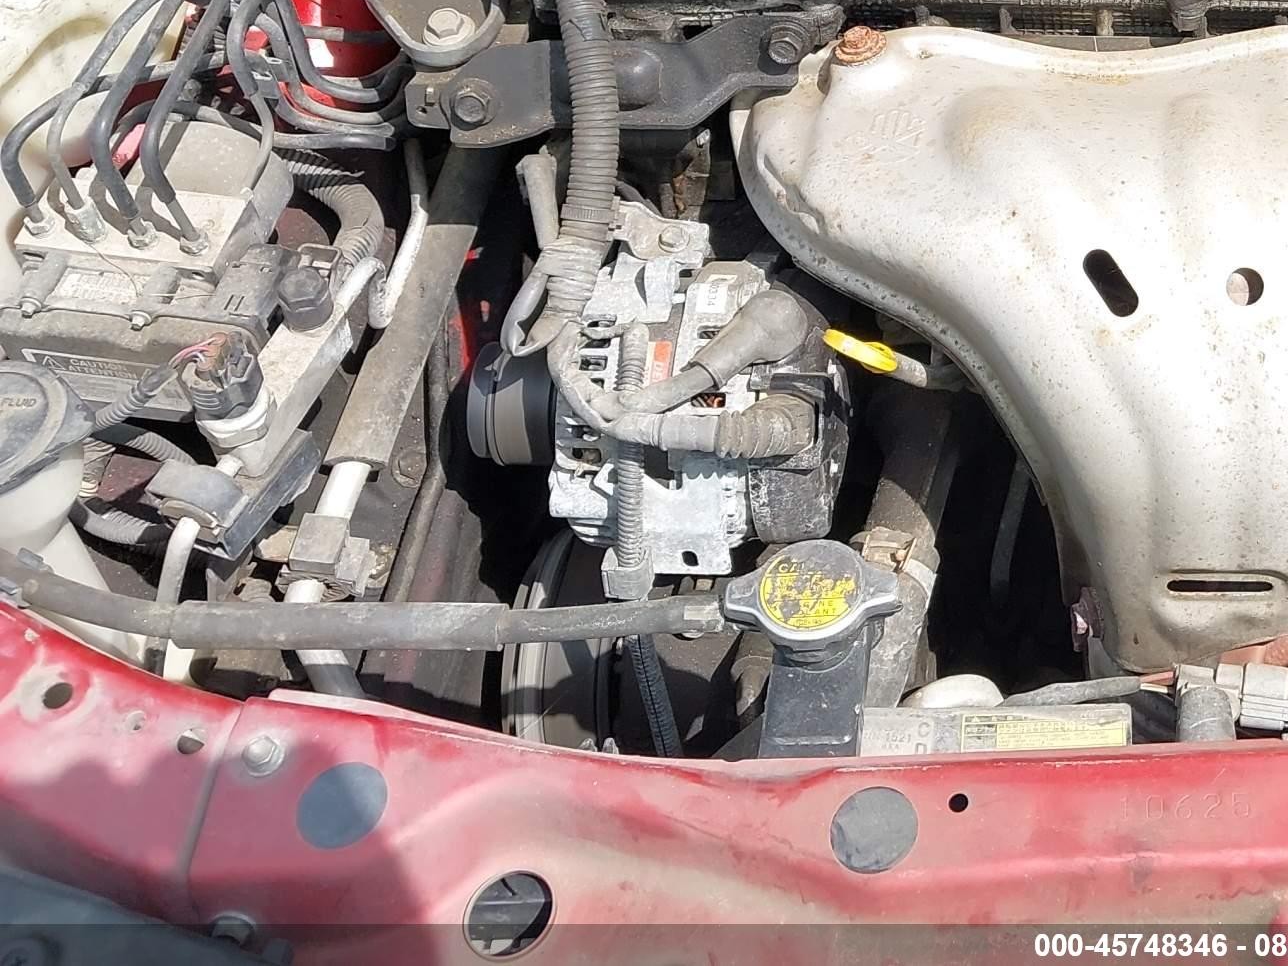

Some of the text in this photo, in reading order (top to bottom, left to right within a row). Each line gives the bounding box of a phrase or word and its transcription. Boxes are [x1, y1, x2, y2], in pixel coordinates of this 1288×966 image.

[69, 358, 127, 372] CAUTION
[68, 365, 138, 380] ATTENTION
[1, 397, 38, 408] FLUID
[1118, 791, 1255, 821] 10625
